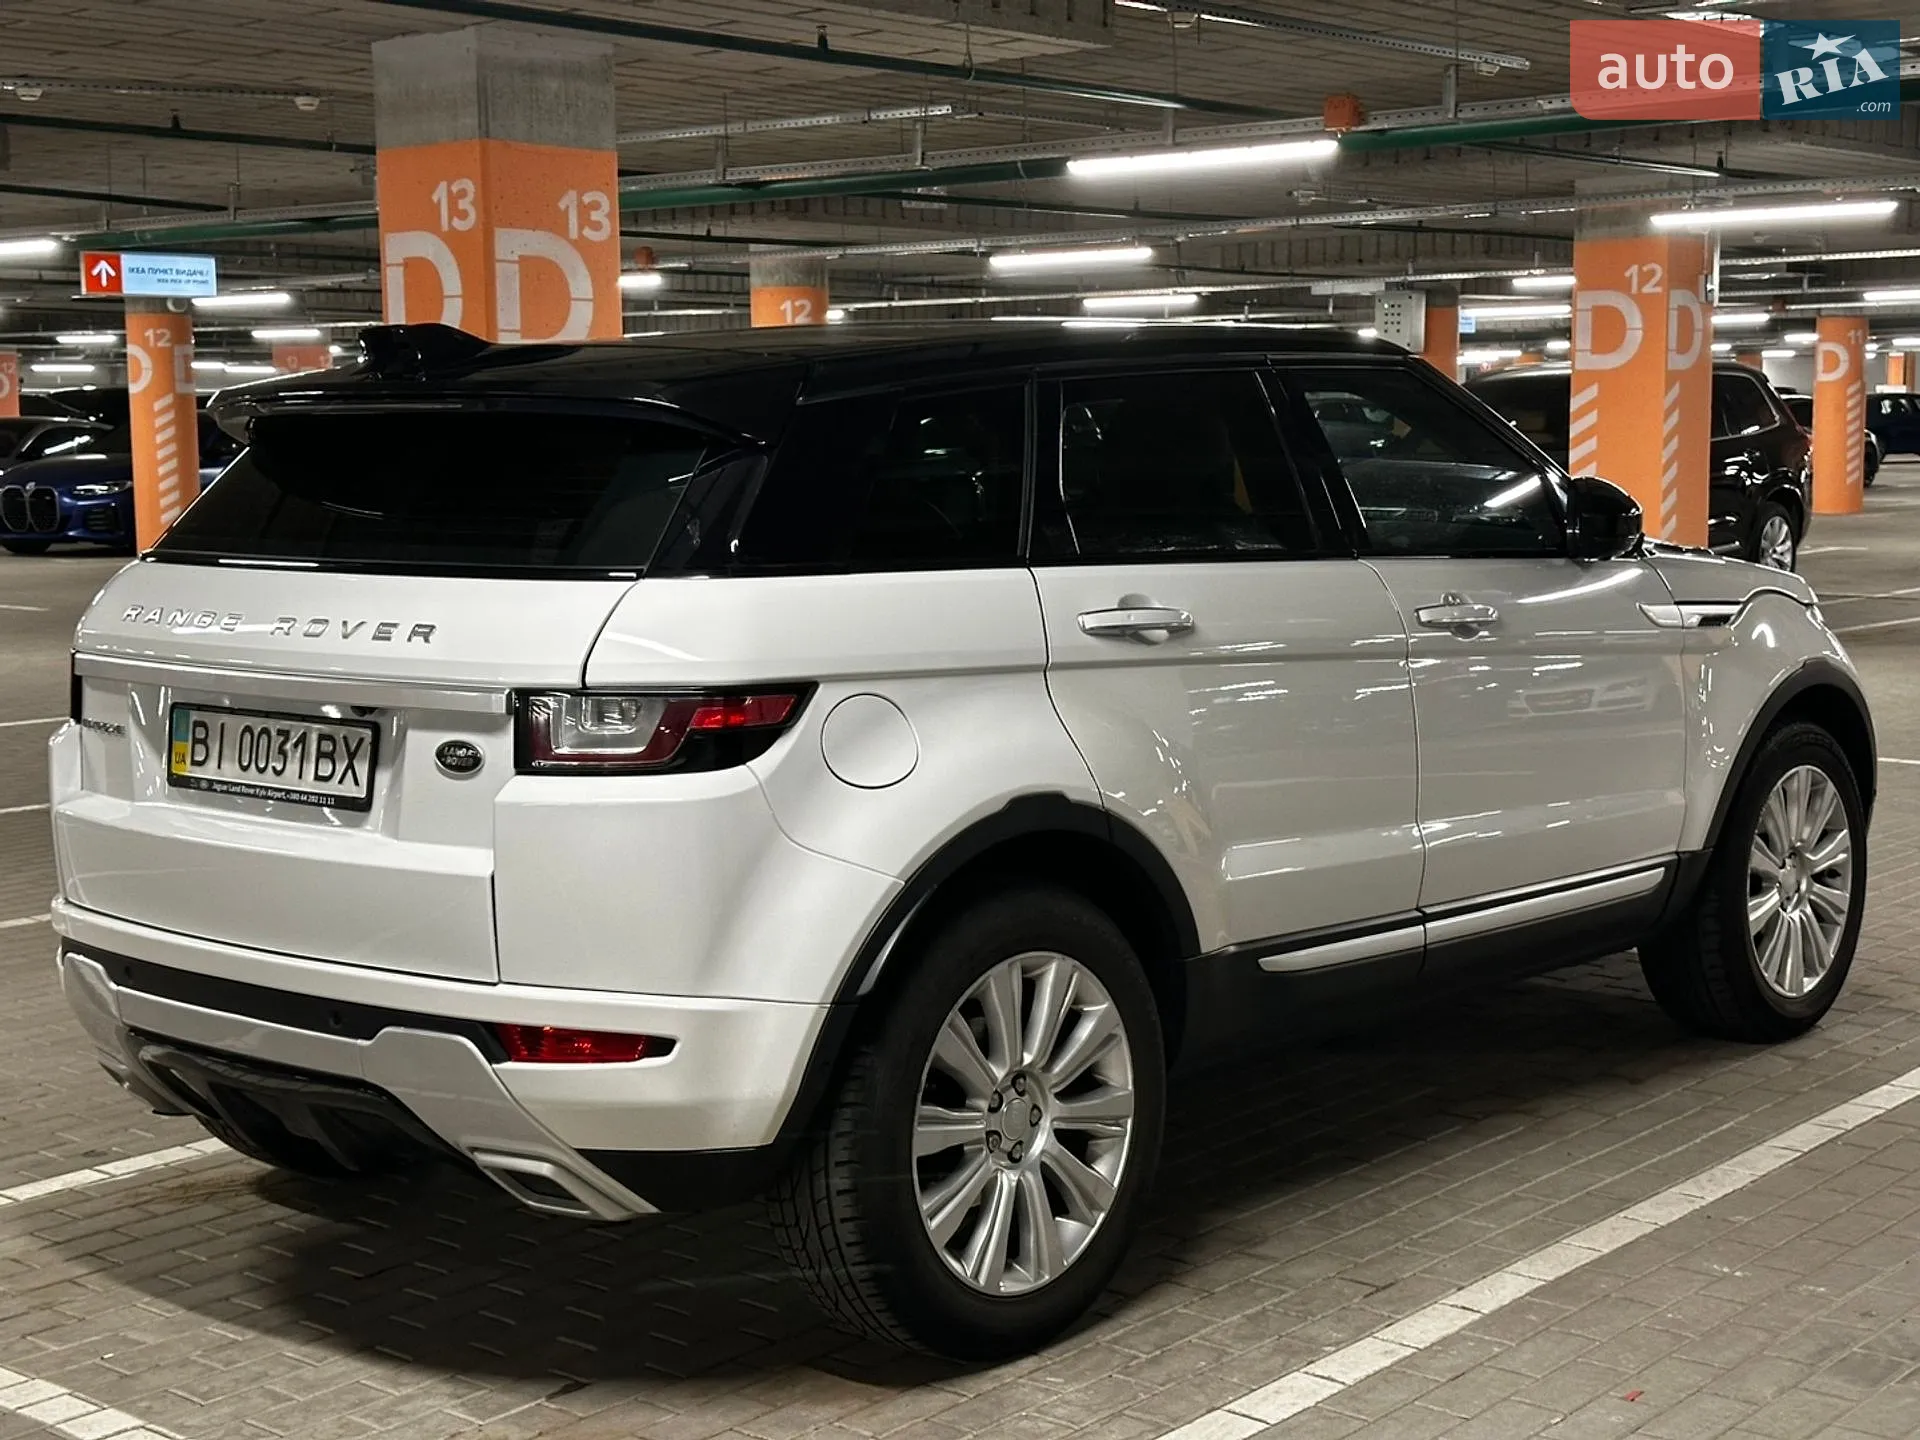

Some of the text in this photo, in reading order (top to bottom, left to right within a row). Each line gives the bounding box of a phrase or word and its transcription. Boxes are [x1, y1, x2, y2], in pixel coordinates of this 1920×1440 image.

[431, 178, 476, 232] 13
[557, 189, 612, 242] 13
[384, 230, 463, 327] D
[494, 227, 594, 343] D
[1624, 262, 1663, 295] 12
[780, 298, 812, 324] 12
[1575, 289, 1643, 370] D
[1667, 289, 1703, 370] D
[144, 328, 172, 347] 12
[1815, 341, 1849, 382] D
[121, 603, 438, 645] RANGE ROVER
[174, 752, 187, 766] UA
[190, 719, 225, 770] BI
